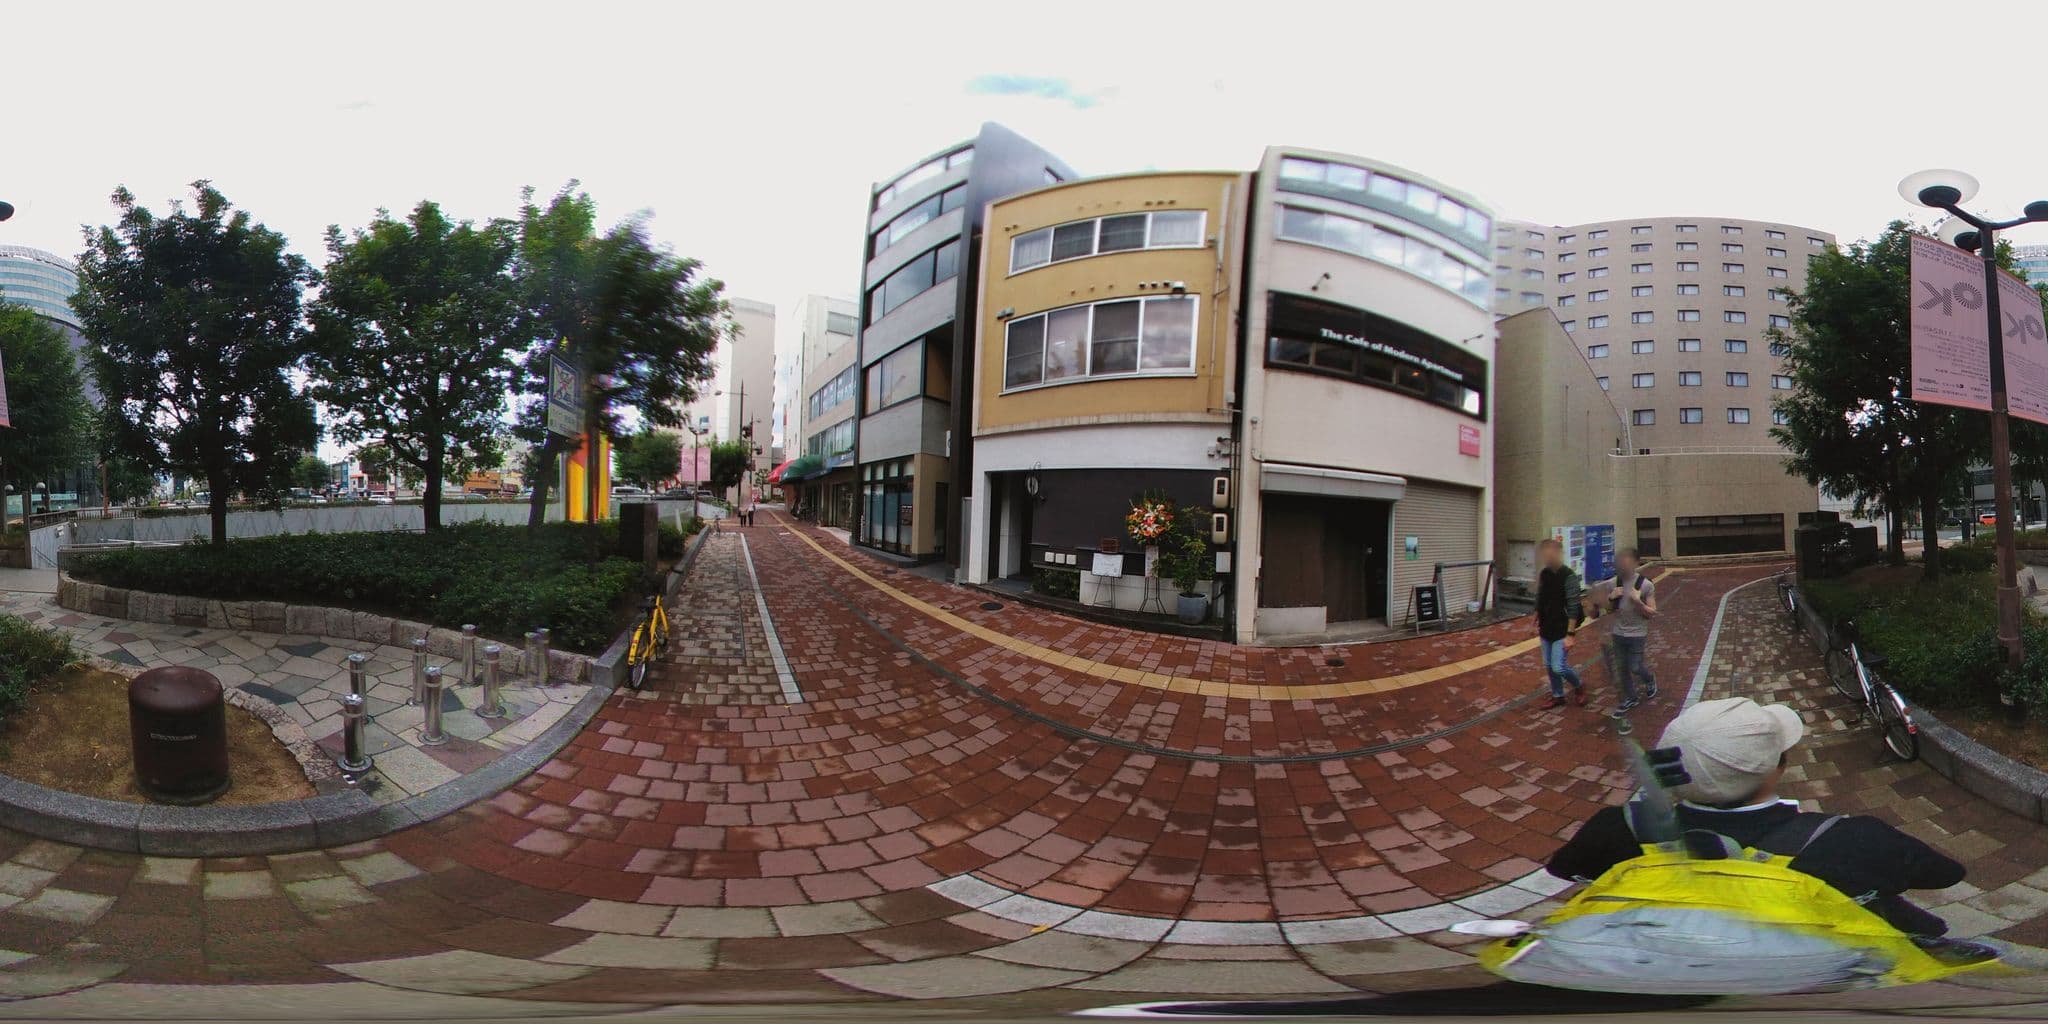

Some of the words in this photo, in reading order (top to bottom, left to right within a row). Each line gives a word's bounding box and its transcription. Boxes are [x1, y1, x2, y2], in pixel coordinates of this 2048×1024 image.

[1320, 328, 1343, 341] The
[1345, 334, 1370, 348] Cafe
[1371, 343, 1383, 351] of
[1383, 345, 1420, 364] Modern
